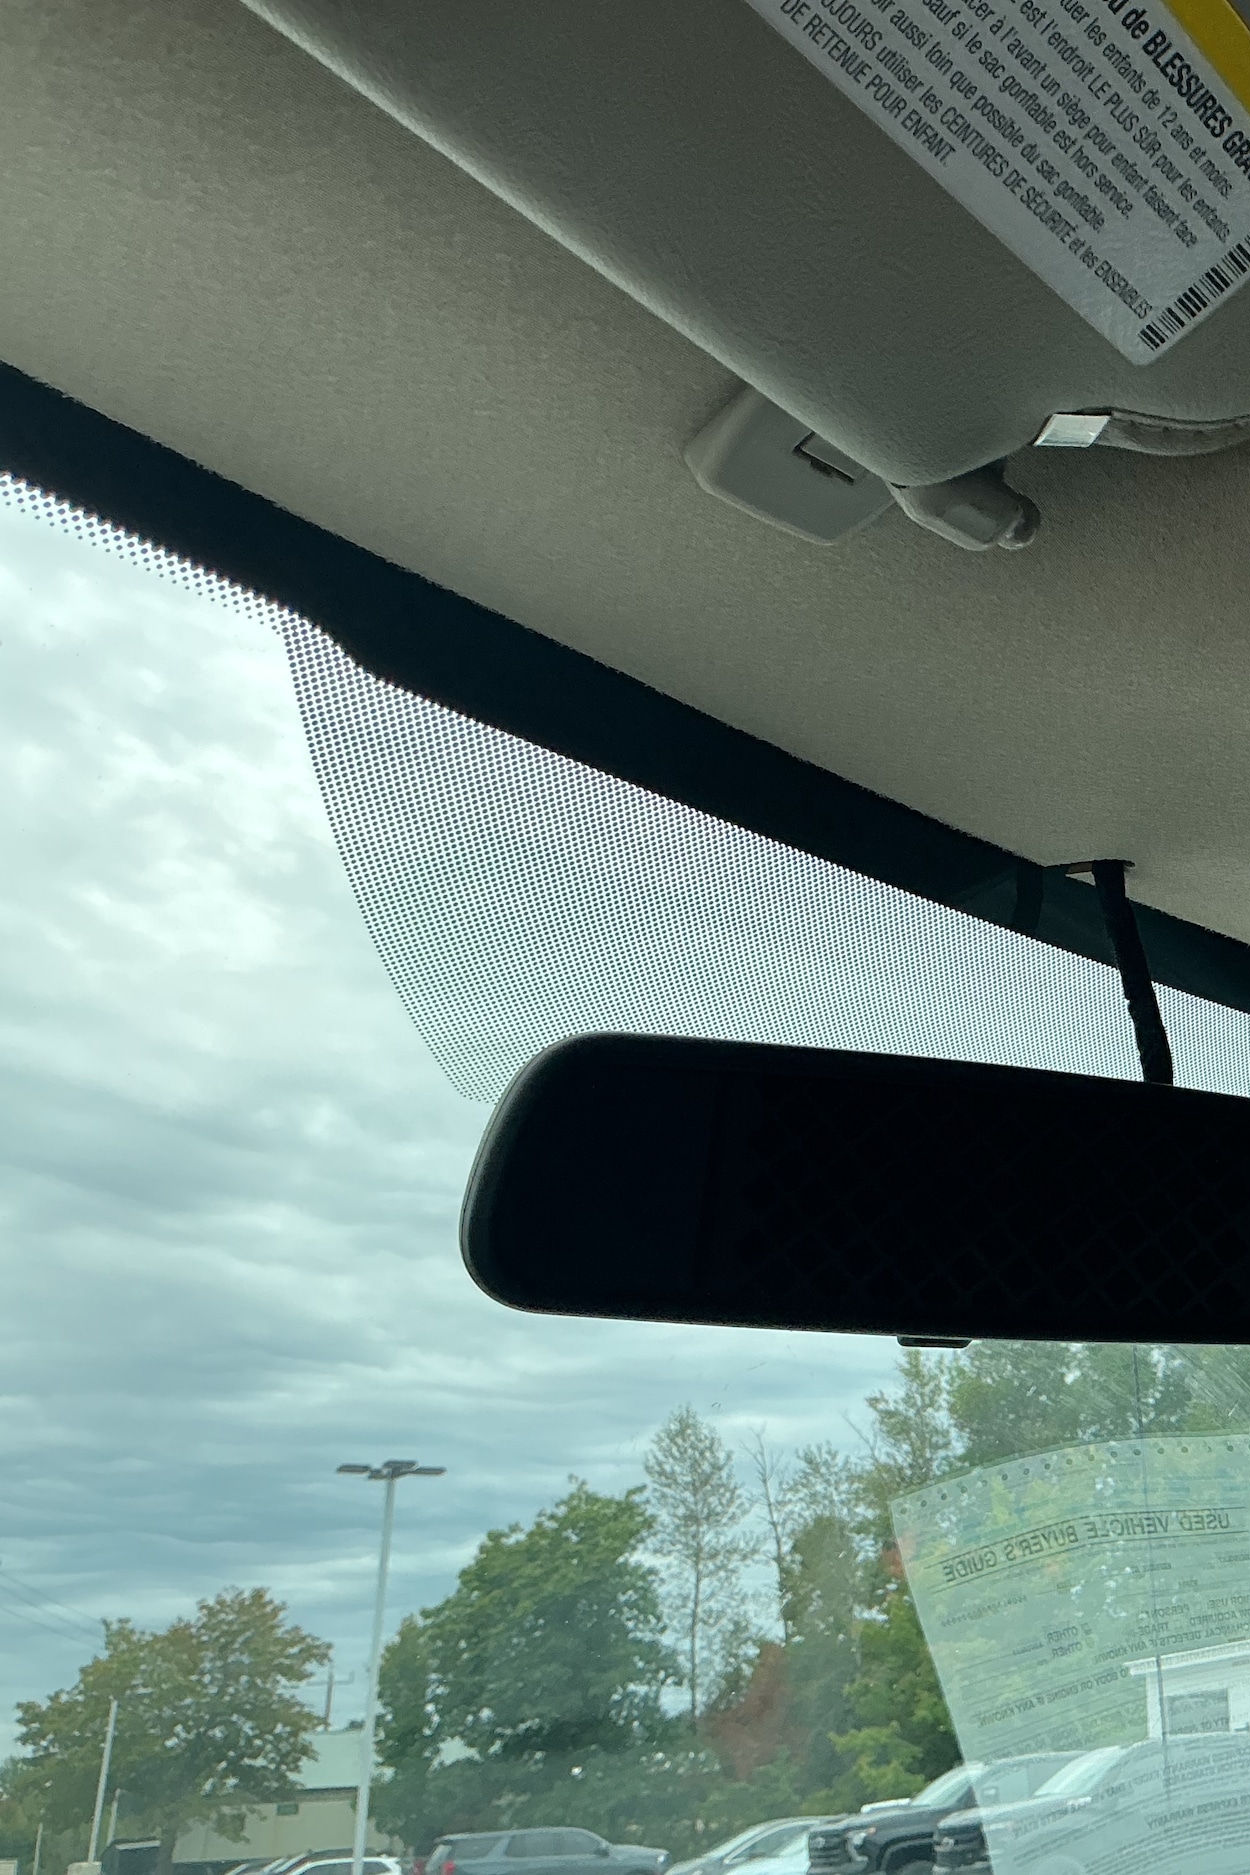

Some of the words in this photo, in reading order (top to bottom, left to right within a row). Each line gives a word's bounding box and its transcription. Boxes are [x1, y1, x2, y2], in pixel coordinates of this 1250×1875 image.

[780, 0, 811, 25] DE
[802, 13, 872, 84] RETENUE
[865, 74, 907, 119] POUR
[901, 109, 956, 165] ENFANT.
[890, 9, 933, 50] aussi
[925, 41, 953, 76] loin
[949, 70, 978, 100] que
[970, 94, 1025, 148] possible
[1020, 143, 1041, 165] du
[1036, 159, 1060, 185] sac
[951, 21, 973, 41] si
[965, 32, 982, 54] le
[978, 50, 1006, 79] sac
[998, 75, 1057, 134] gonflable
[1052, 130, 1077, 154] est
[1070, 145, 1099, 178] hors
[1094, 173, 1133, 220] service.
[989, 15, 1006, 36] à
[1000, 26, 1047, 80] l'avant
[1040, 74, 1061, 97] un
[1057, 92, 1091, 129] siège
[1083, 124, 1117, 155] pour
[1111, 153, 1149, 193] enfant
[1142, 184, 1181, 228] faisant
[1173, 219, 1198, 248] face
[1020, 0, 1047, 28] est
[1040, 18, 1095, 82] l'endroit
[1087, 74, 1112, 100] LE
[1103, 91, 1140, 133] PLUS
[1132, 125, 1162, 159] SÛR
[1151, 154, 1184, 184] pour
[1177, 177, 1198, 203] les
[1083, 17, 1107, 47] les
[1102, 42, 1146, 94] enfants
[1141, 89, 1161, 110] de
[1157, 105, 1178, 129] 12
[1170, 124, 1194, 150] ans
[1189, 146, 1207, 164] et
[1199, 159, 1233, 200] moins.
[1121, 8, 1149, 39] de
[1142, 29, 1233, 138] BLESSURES
[875, 46, 924, 93] utiliser
[919, 86, 943, 115] les
[940, 107, 1009, 177] CEINTURES
[1002, 169, 1027, 195] DE
[1019, 186, 1078, 244] SÉCURITÉ
[1068, 238, 1086, 255] et
[1079, 245, 1099, 269] les
[1094, 260, 1153, 319] ENSEMBLES
